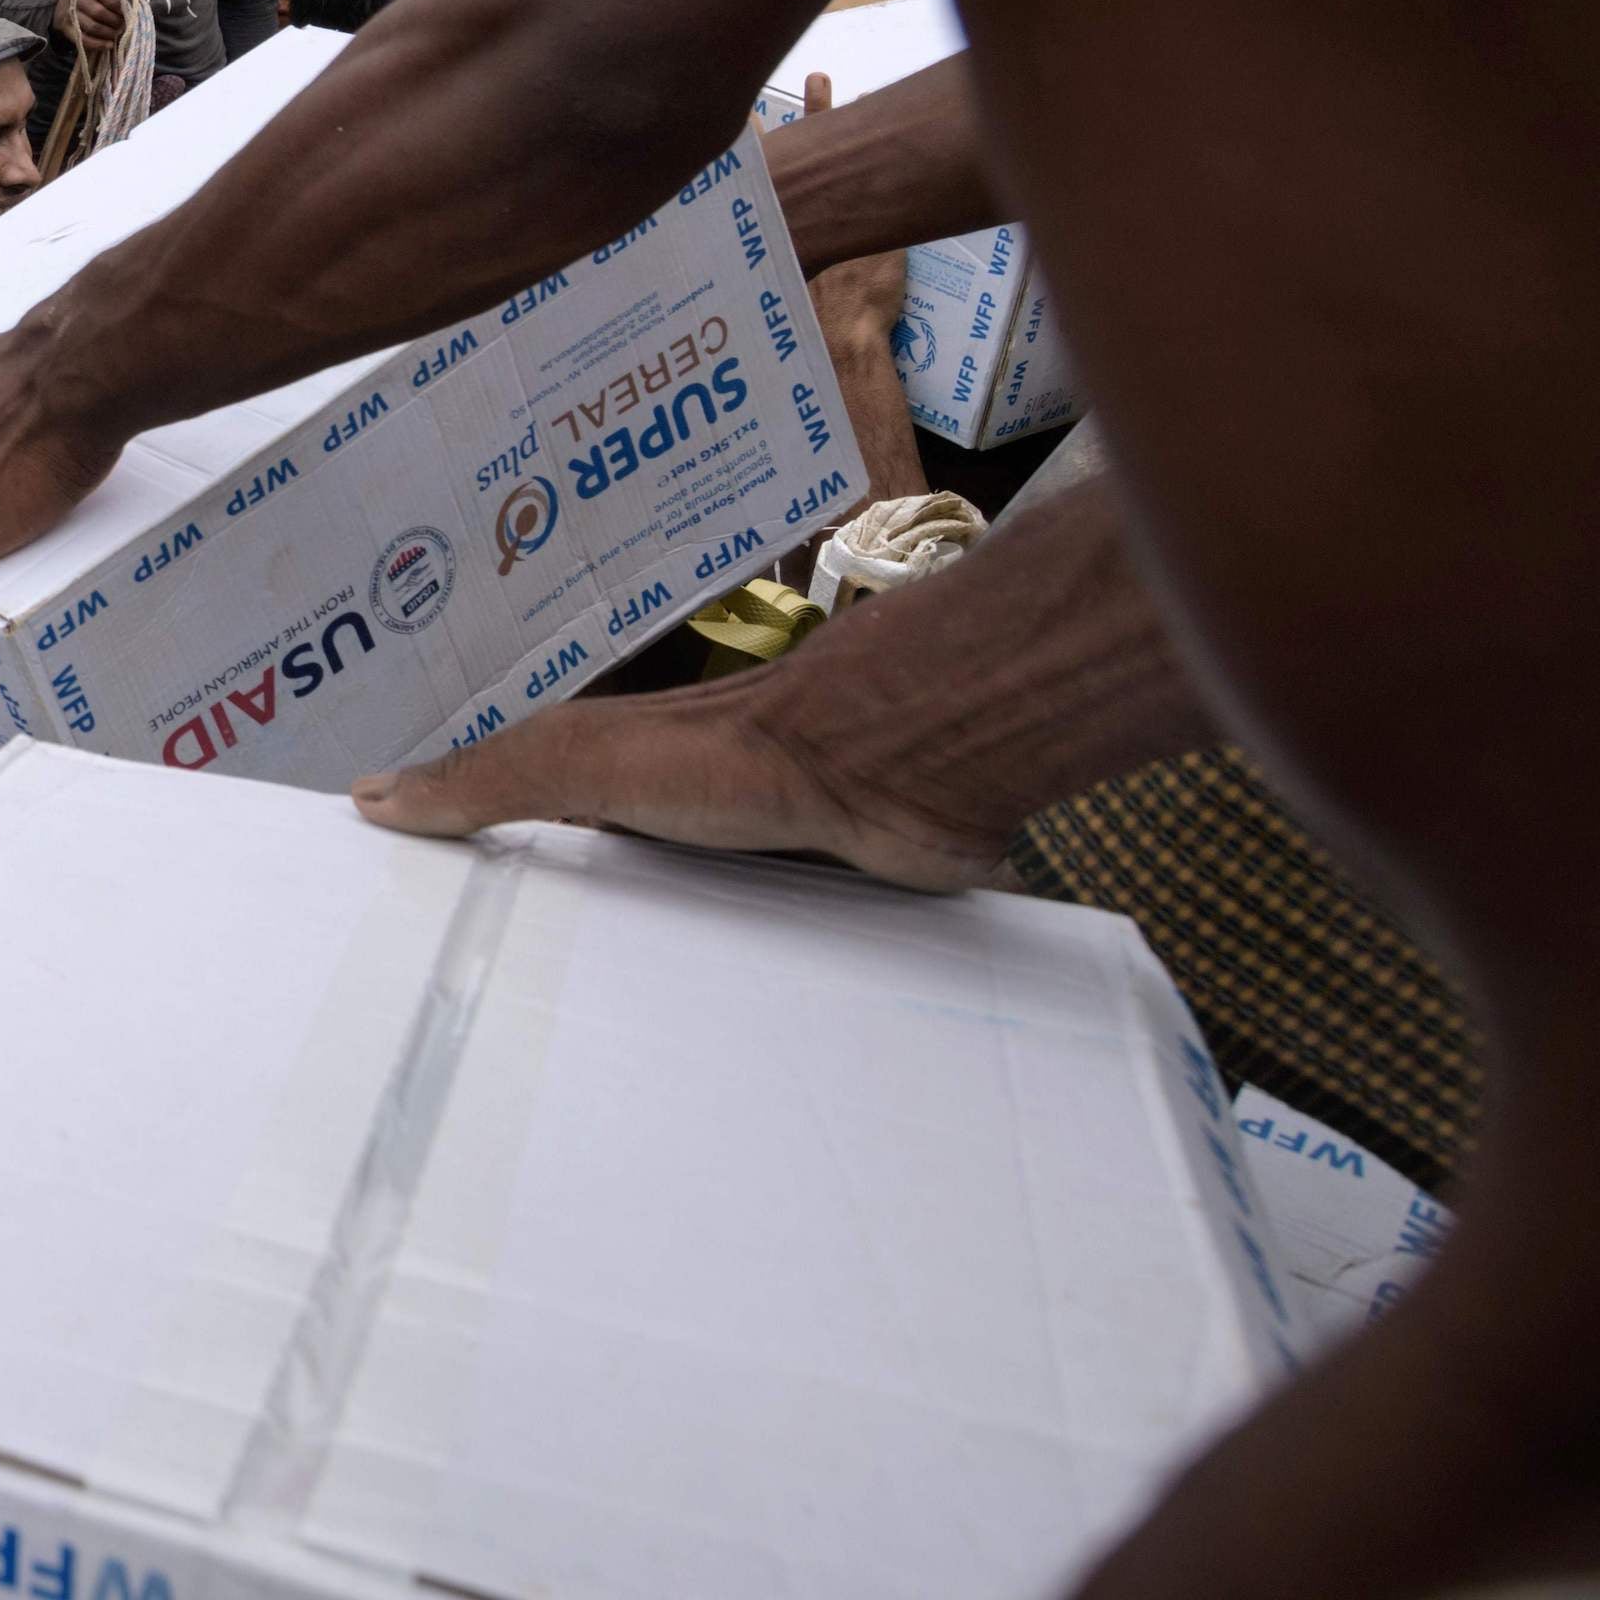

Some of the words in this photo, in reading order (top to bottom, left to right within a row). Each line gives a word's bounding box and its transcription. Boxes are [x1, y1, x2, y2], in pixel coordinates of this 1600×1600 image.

[678, 149, 742, 206] WFP
[731, 198, 767, 270] WFP
[988, 227, 1014, 276] WFP
[502, 268, 568, 324] WFP
[969, 292, 996, 340] WFP
[760, 291, 797, 362] WFP
[1025, 298, 1046, 344] WFP
[413, 330, 478, 387] WFP
[552, 317, 727, 440] CEREAL
[952, 355, 978, 403] WFP
[1006, 360, 1029, 406] WFP
[324, 393, 388, 452] WFP
[568, 358, 746, 499] SUPER
[700, 419, 758, 461] 9x1.5KG
[793, 384, 830, 453] WFP
[996, 416, 1031, 437] WFP
[477, 421, 539, 491] plus
[671, 459, 696, 478] Net
[716, 447, 761, 477] months
[734, 453, 772, 484] Special
[227, 459, 298, 515] WFP
[654, 488, 687, 512] above
[684, 480, 731, 510] Formula
[692, 474, 712, 492] and
[704, 494, 735, 515] Soya
[738, 468, 777, 496] Wheat
[786, 471, 848, 523] WFP
[623, 520, 663, 549] Infants
[665, 513, 701, 540] Blend
[667, 509, 682, 522] for
[135, 523, 203, 582] WFP
[566, 562, 598, 588] Young
[600, 547, 619, 565] and
[696, 528, 764, 578] WFP
[38, 591, 108, 650] WFP
[314, 586, 354, 619] FROM
[406, 584, 436, 613] USAID
[522, 586, 563, 621] Children
[609, 582, 672, 635] WFP
[283, 617, 312, 641] THE
[164, 612, 375, 768] USAID
[204, 637, 278, 695] AMERICAN
[527, 641, 588, 698] WFP
[51, 664, 95, 733] WFP
[149, 689, 202, 732] PEOPLE
[1238, 1117, 1365, 1178] WFP
